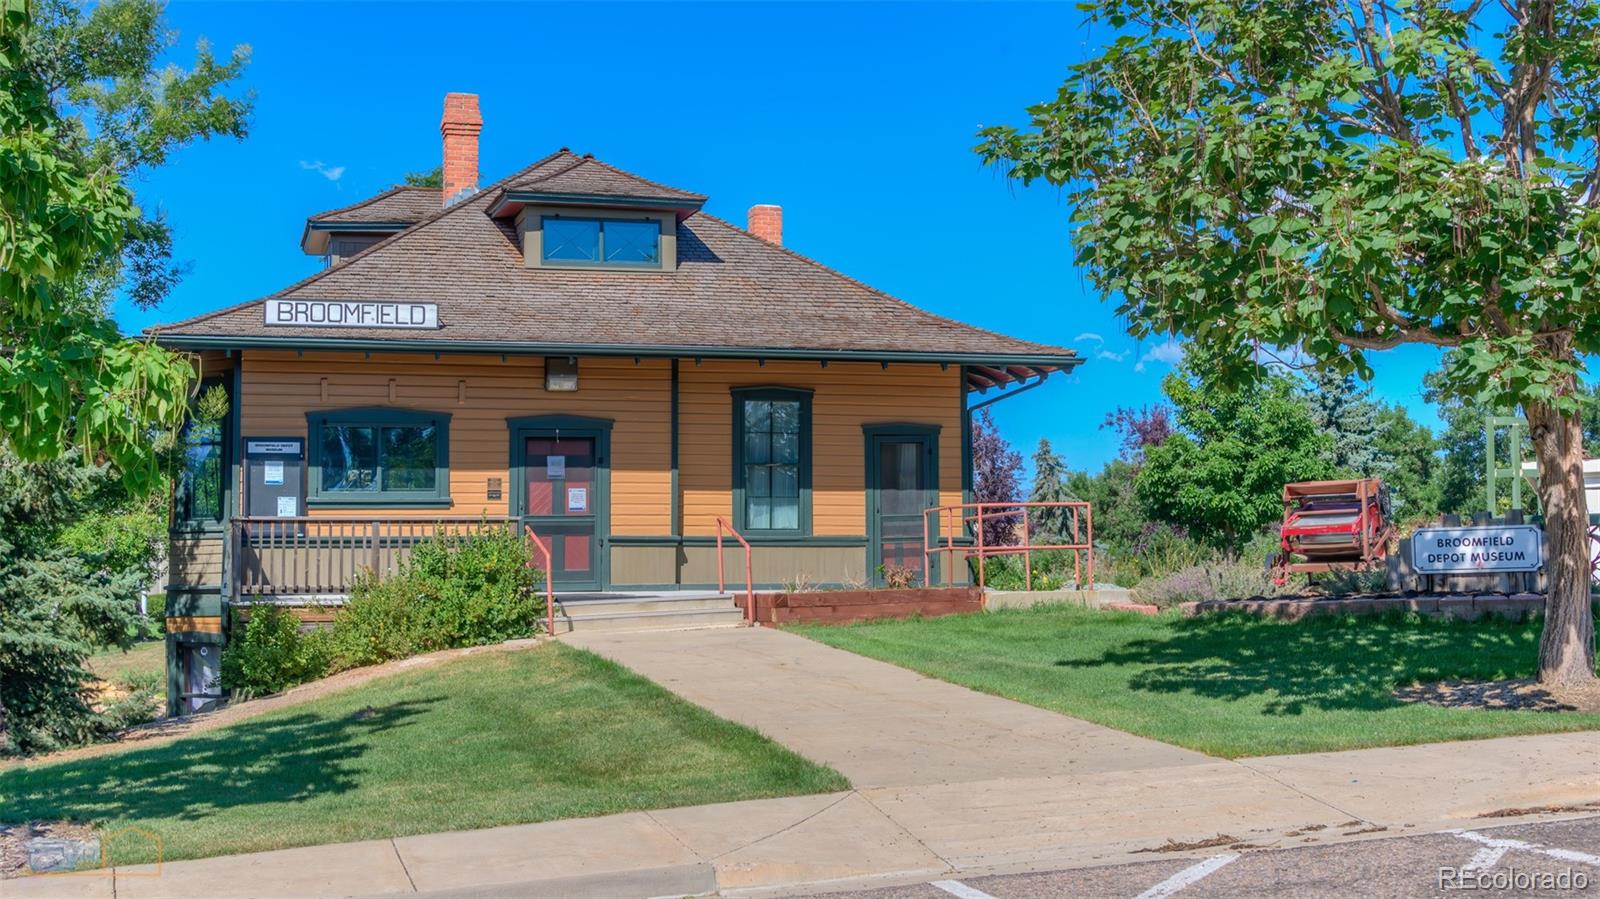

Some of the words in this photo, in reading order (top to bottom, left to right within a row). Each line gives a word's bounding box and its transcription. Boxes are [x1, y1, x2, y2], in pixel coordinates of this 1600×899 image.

[277, 302, 426, 325] BROOMFIELD
[1437, 536, 1514, 548] BROOMFIELD
[1428, 553, 1467, 563] DEPOT
[1470, 551, 1525, 562] MUSEUM
